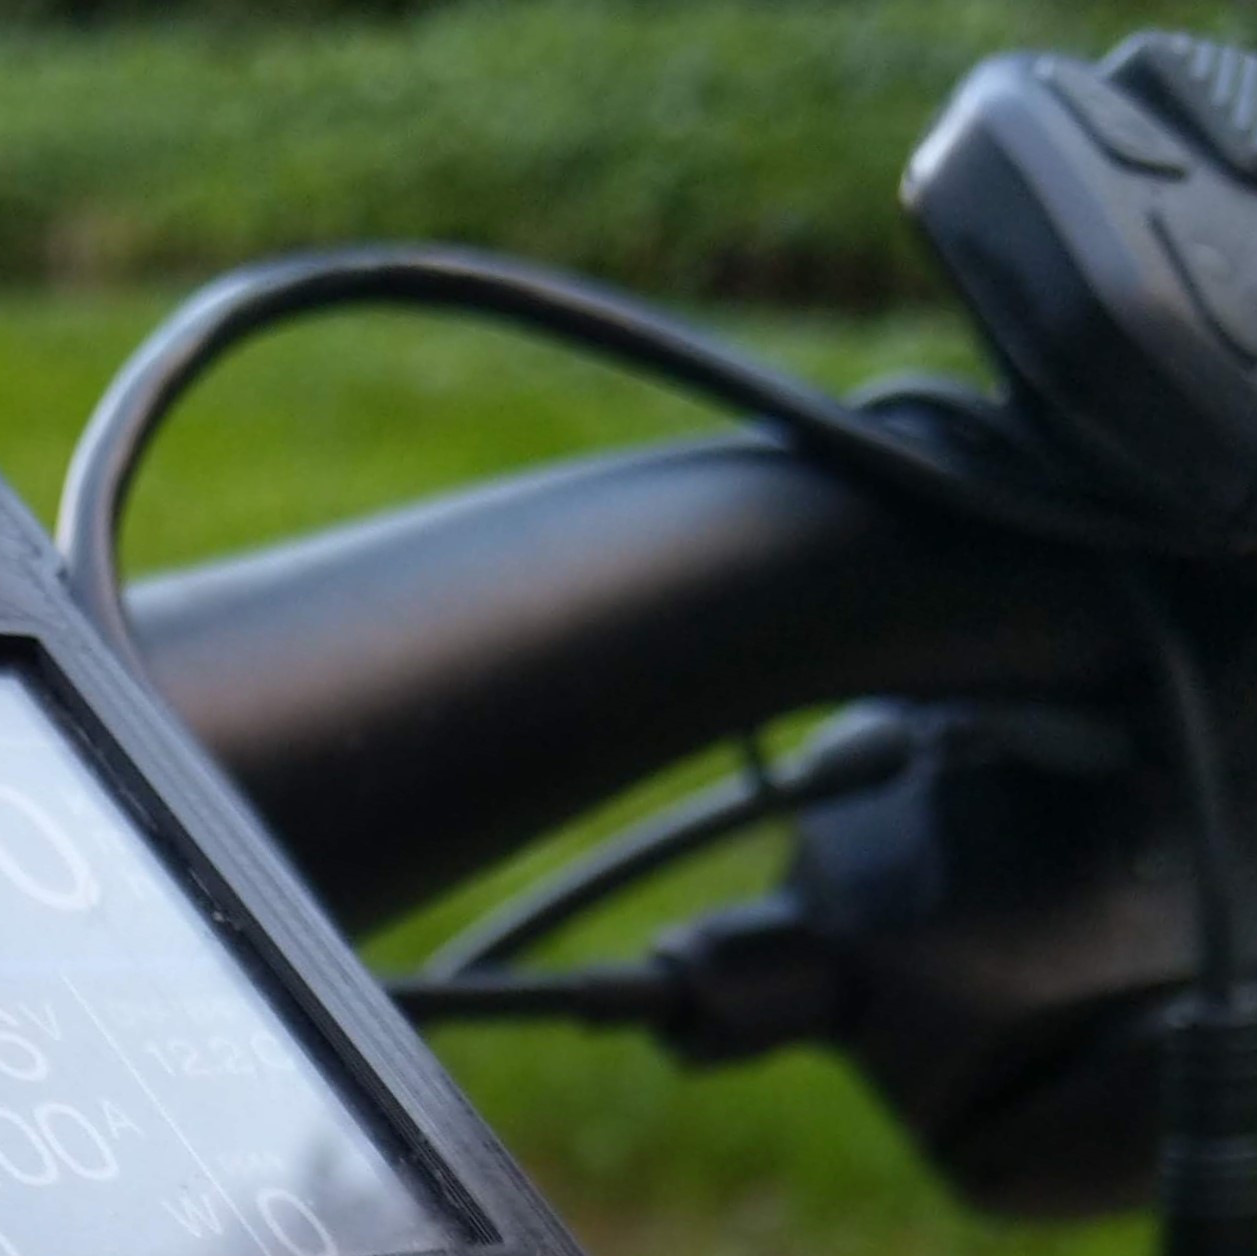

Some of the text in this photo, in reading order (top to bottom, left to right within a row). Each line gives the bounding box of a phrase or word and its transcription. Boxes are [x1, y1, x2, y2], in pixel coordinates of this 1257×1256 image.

[18, 1002, 64, 1042] V
[98, 1097, 146, 1141] A
[161, 1193, 225, 1240] W
